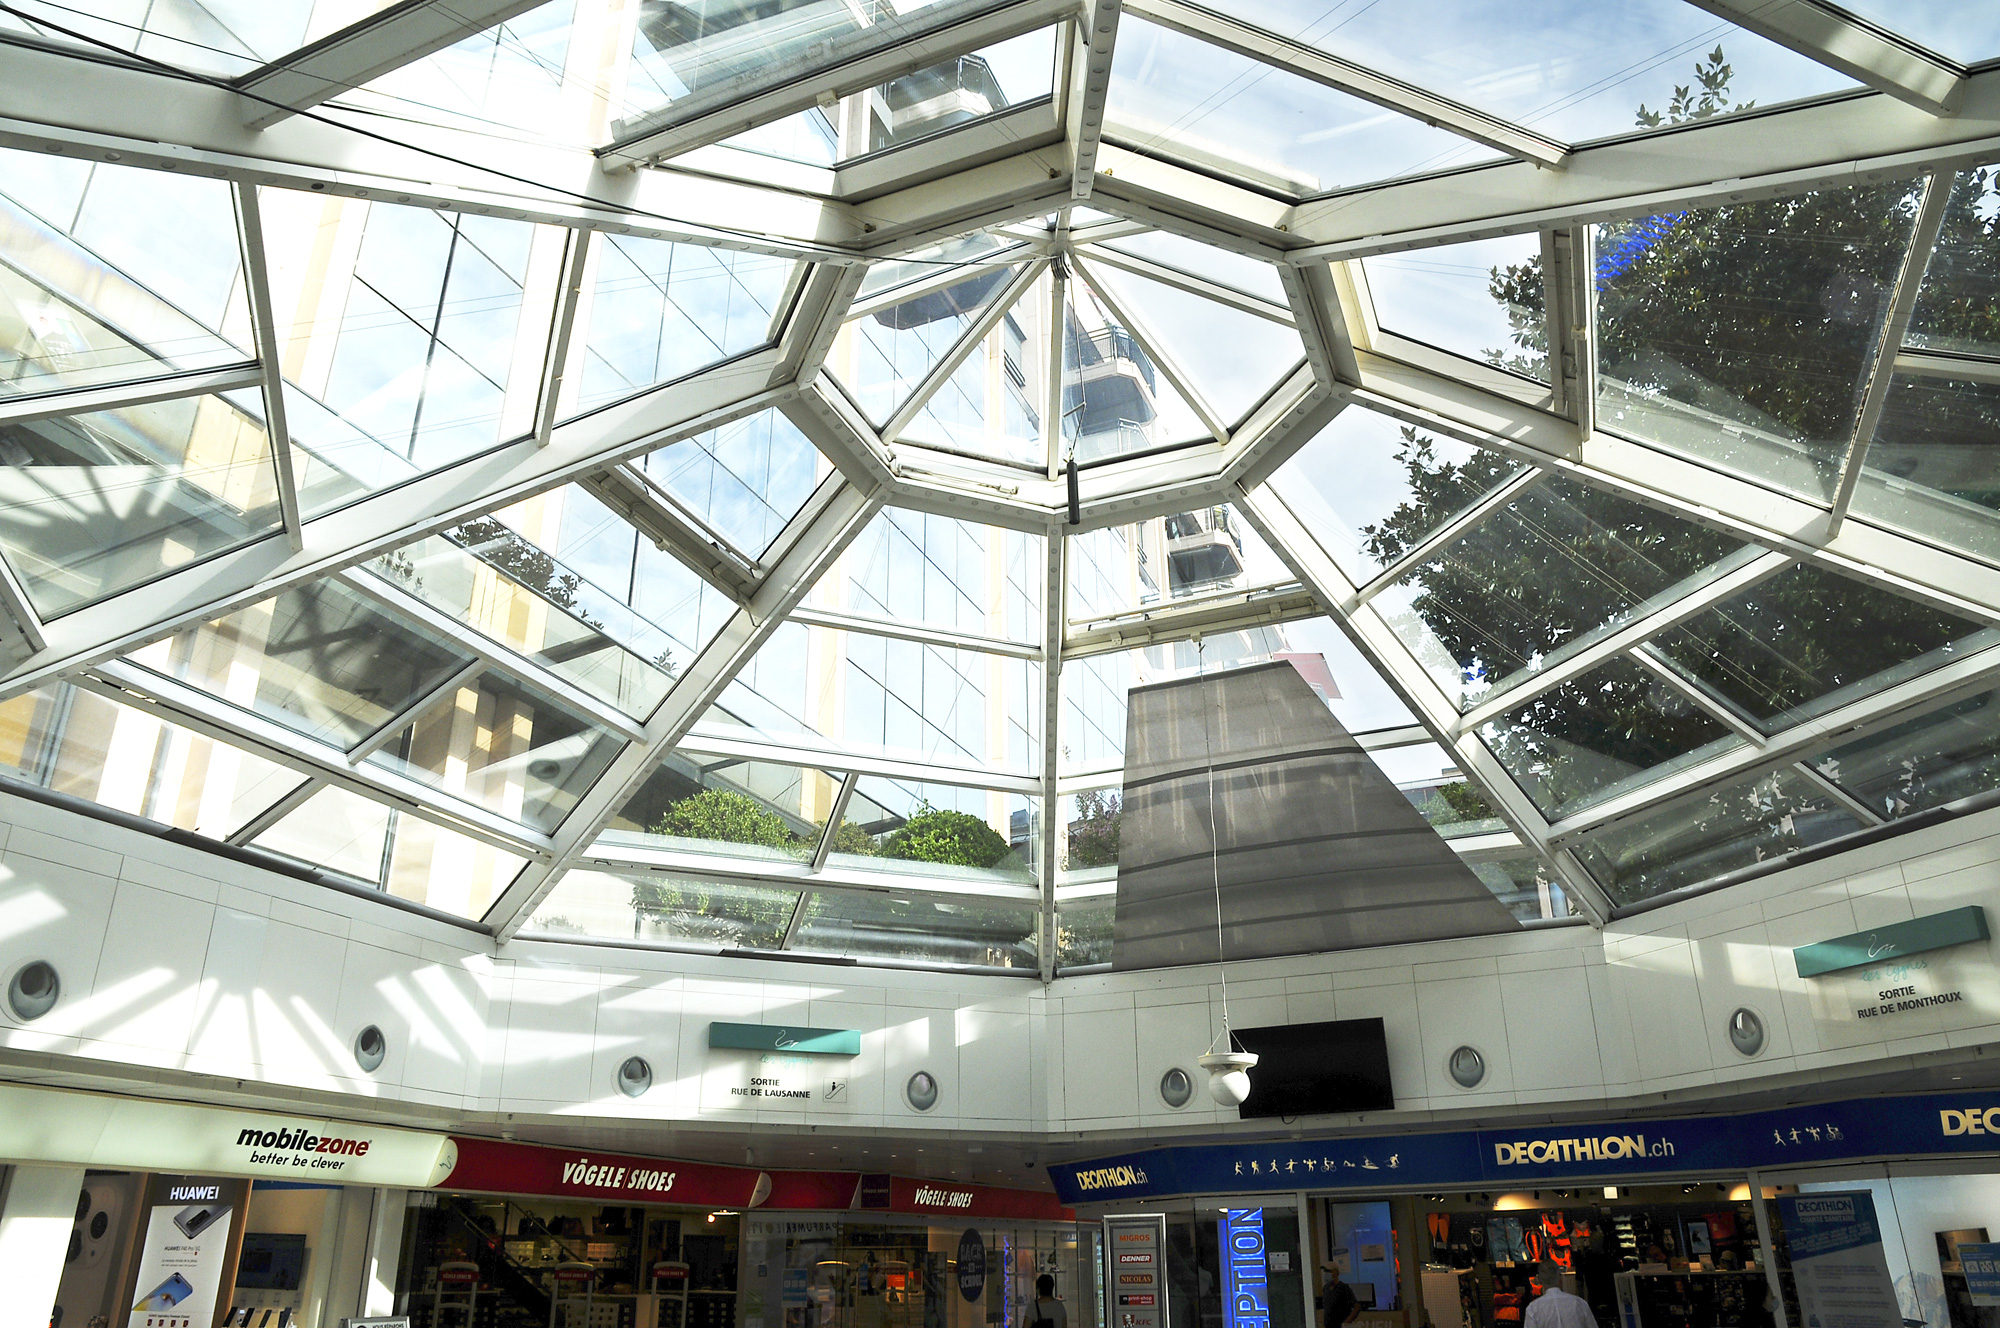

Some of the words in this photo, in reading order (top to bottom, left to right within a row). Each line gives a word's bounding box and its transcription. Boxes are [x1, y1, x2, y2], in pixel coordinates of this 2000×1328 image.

[1879, 985, 1916, 1000] SORTIE
[1857, 1005, 1879, 1019] RUE
[1880, 1003, 1895, 1015] DE
[1897, 991, 1963, 1012] MONTHOUX
[750, 1077, 780, 1087] SORTIE
[731, 1087, 748, 1096] RUE
[750, 1088, 763, 1097] DE
[764, 1089, 811, 1099] LAUSANNE
[236, 1127, 370, 1157] mobilezone
[1494, 1134, 1675, 1166] DECATHLON.ch
[249, 1150, 289, 1166] better
[291, 1153, 308, 1167] be
[311, 1156, 345, 1170] clever
[627, 1169, 676, 1192] SHOES
[169, 1186, 220, 1200] HUAWEI
[947, 1191, 973, 1208] SHOES
[1797, 1200, 1853, 1213] DECATHLON
[1119, 1234, 1150, 1242] MIGROS
[1120, 1275, 1152, 1283] NICOLAS
